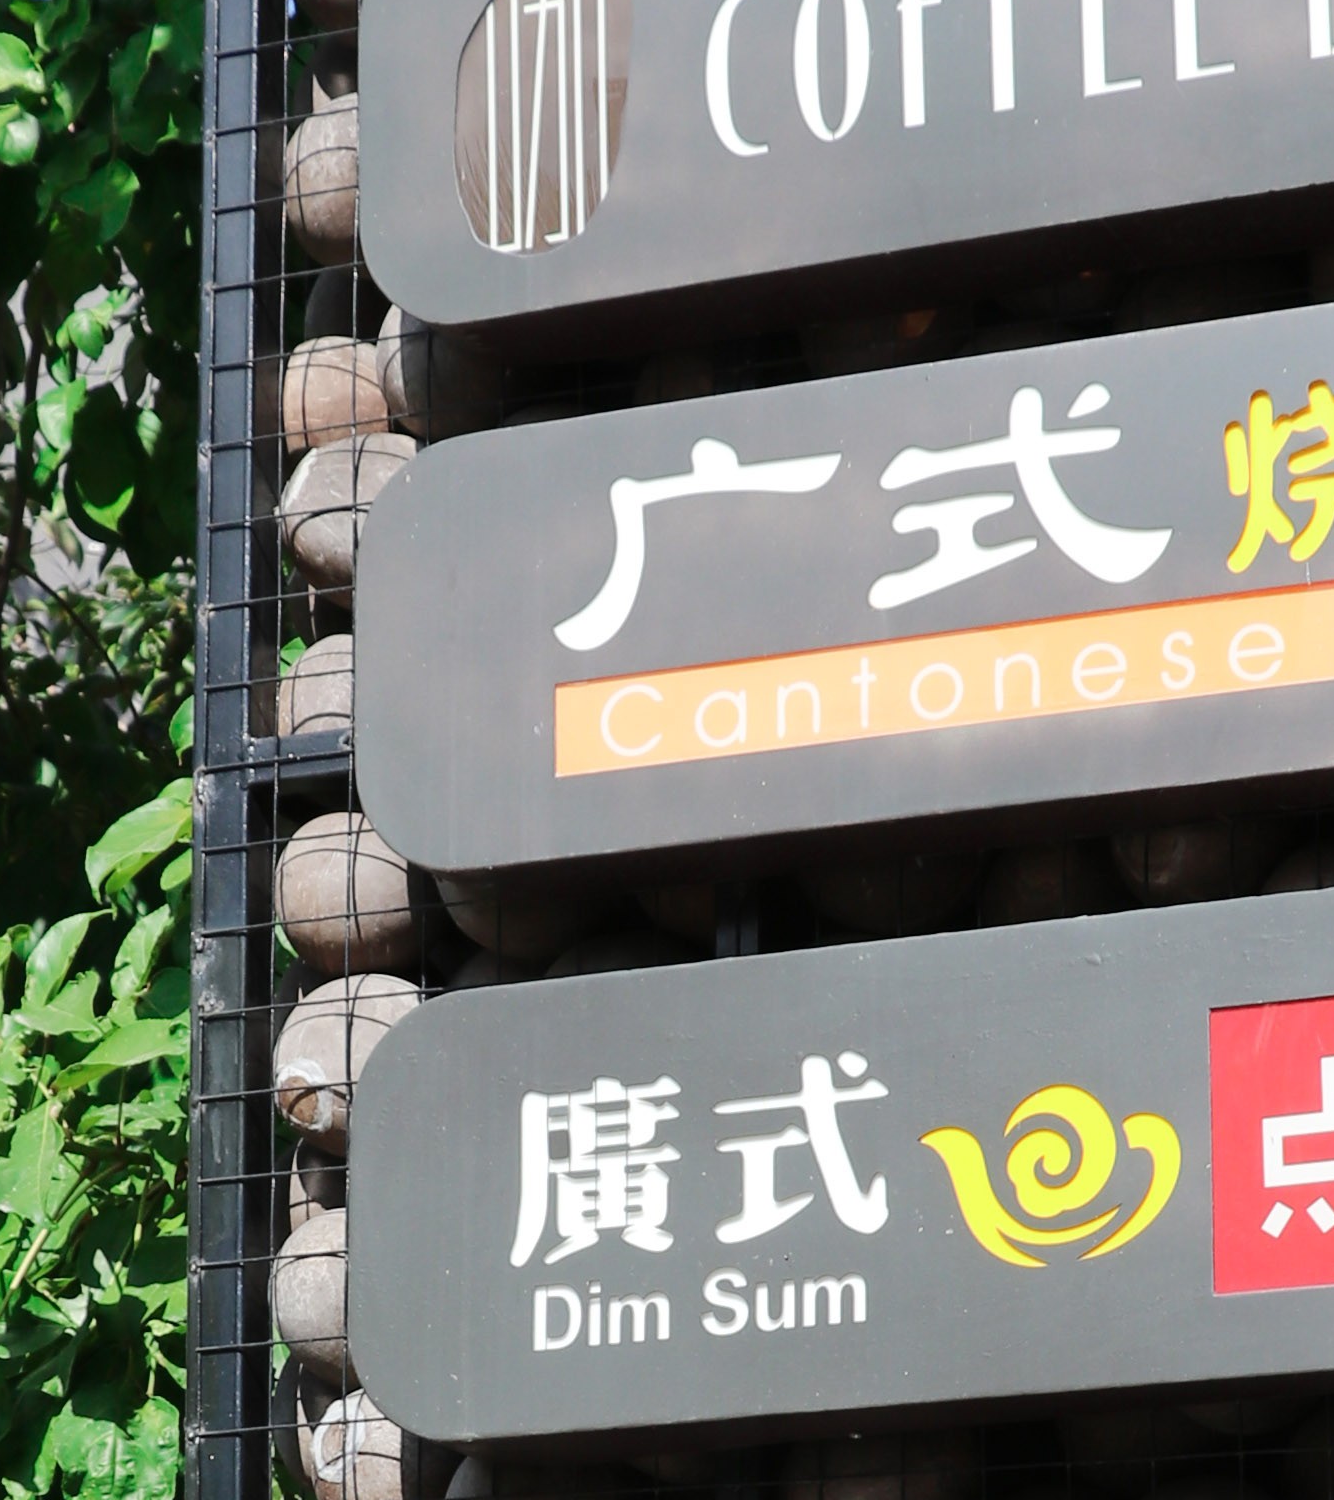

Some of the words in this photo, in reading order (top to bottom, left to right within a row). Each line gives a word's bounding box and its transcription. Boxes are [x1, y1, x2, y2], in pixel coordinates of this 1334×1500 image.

[599, 618, 1285, 757] Cantonese
[510, 1052, 888, 1267] 廣式
[534, 1285, 669, 1350] Dim
[703, 1272, 866, 1335] Sum
